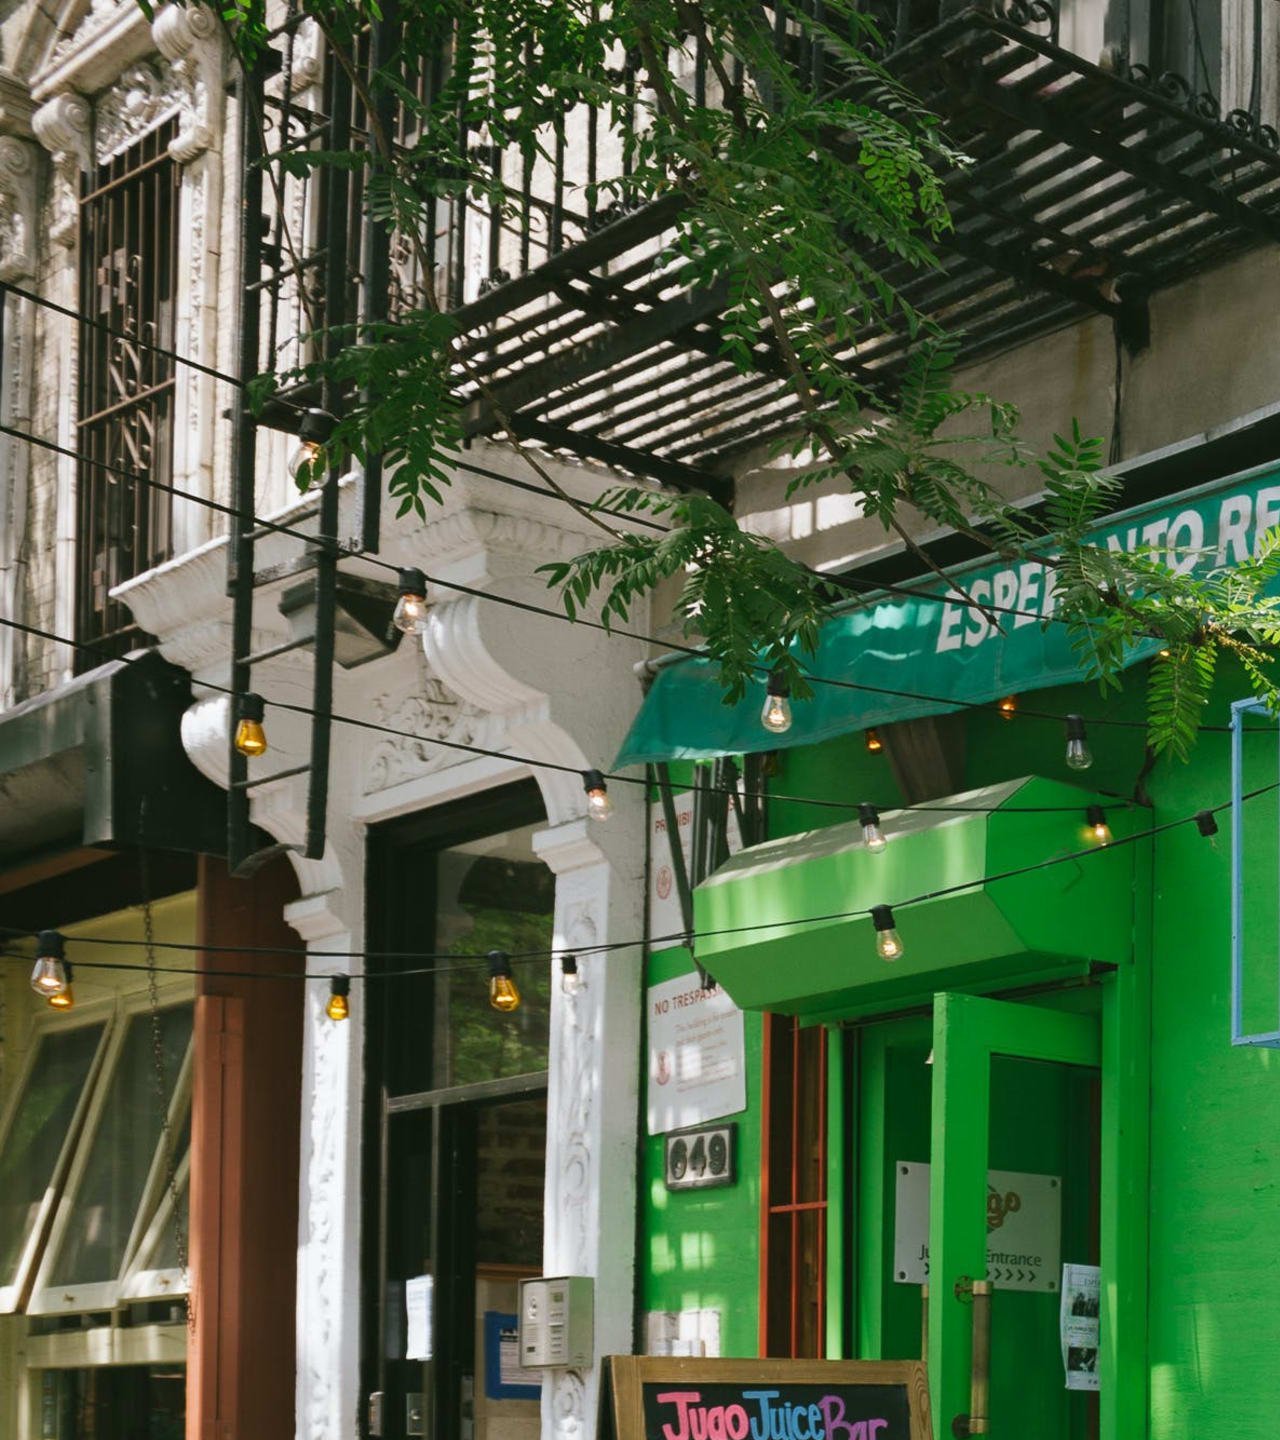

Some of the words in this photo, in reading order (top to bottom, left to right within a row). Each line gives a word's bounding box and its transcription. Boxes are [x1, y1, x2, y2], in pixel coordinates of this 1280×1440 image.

[655, 1000, 669, 1016] NO
[670, 1133, 726, 1180] 649
[986, 1249, 1042, 1267] Entrance
